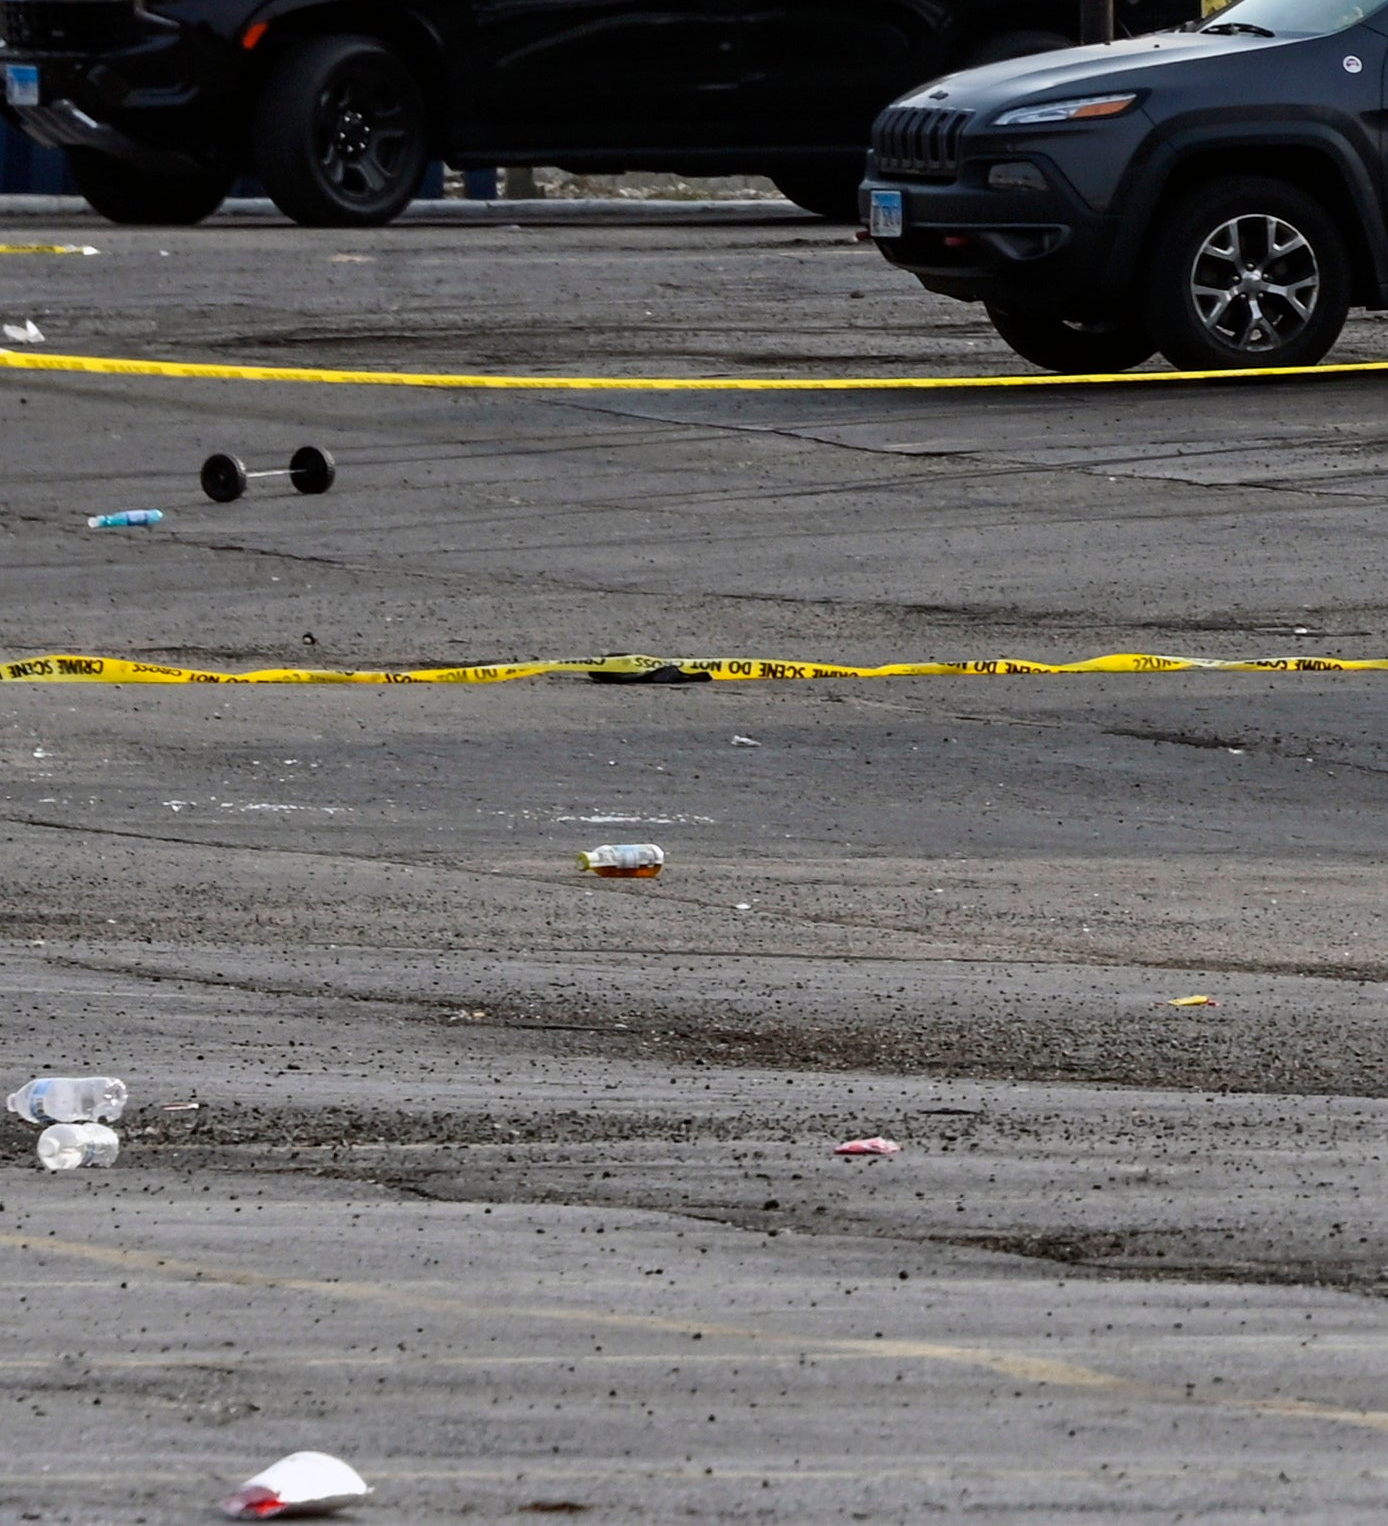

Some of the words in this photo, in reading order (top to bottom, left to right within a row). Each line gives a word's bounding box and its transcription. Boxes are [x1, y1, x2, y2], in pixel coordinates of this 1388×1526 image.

[7, 659, 52, 677] SCENE
[57, 658, 104, 675] CRIME
[692, 659, 722, 672] NOT
[728, 660, 752, 675] DO
[758, 662, 806, 679] SCENE
